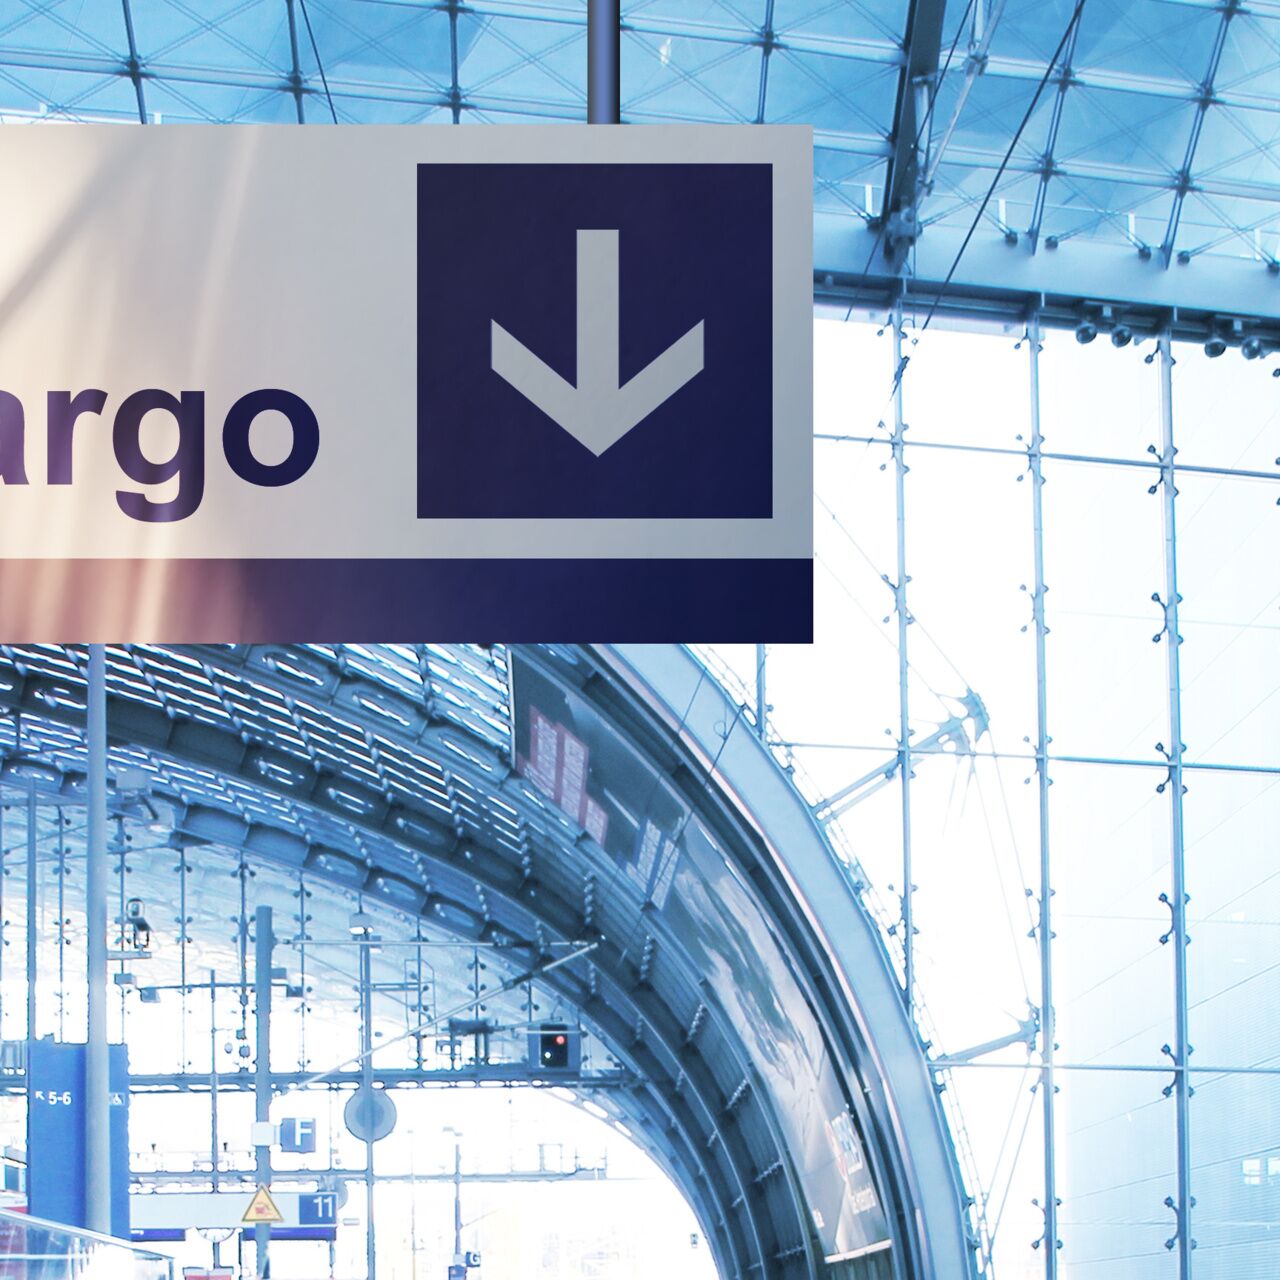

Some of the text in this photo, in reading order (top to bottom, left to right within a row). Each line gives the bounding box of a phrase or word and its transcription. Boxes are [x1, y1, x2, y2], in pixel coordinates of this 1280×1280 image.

[48, 1091, 72, 1106] 5-6
[295, 1118, 313, 1146] F
[313, 1196, 333, 1218] 11
[470, 1252, 481, 1265] G
